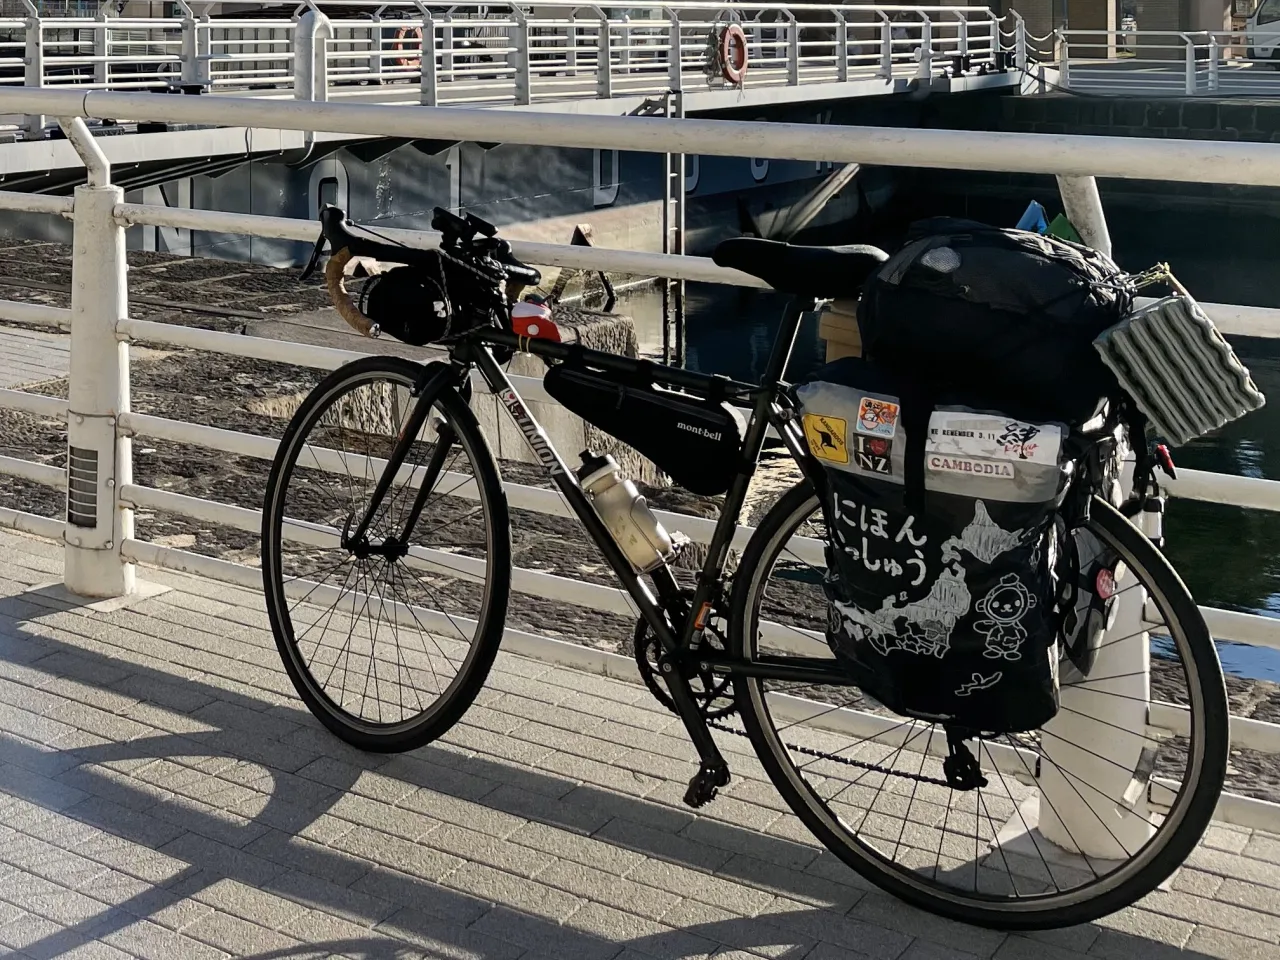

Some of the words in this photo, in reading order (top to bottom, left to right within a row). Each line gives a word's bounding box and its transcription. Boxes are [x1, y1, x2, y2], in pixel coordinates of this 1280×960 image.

[819, 417, 845, 447] KANGAROOS
[930, 428, 939, 436] WE
[942, 429, 975, 439] REMEMBER
[857, 436, 865, 453] I
[858, 453, 889, 474] NZ
[931, 457, 1012, 477] CAMBODIA
[833, 492, 928, 547] にほん
